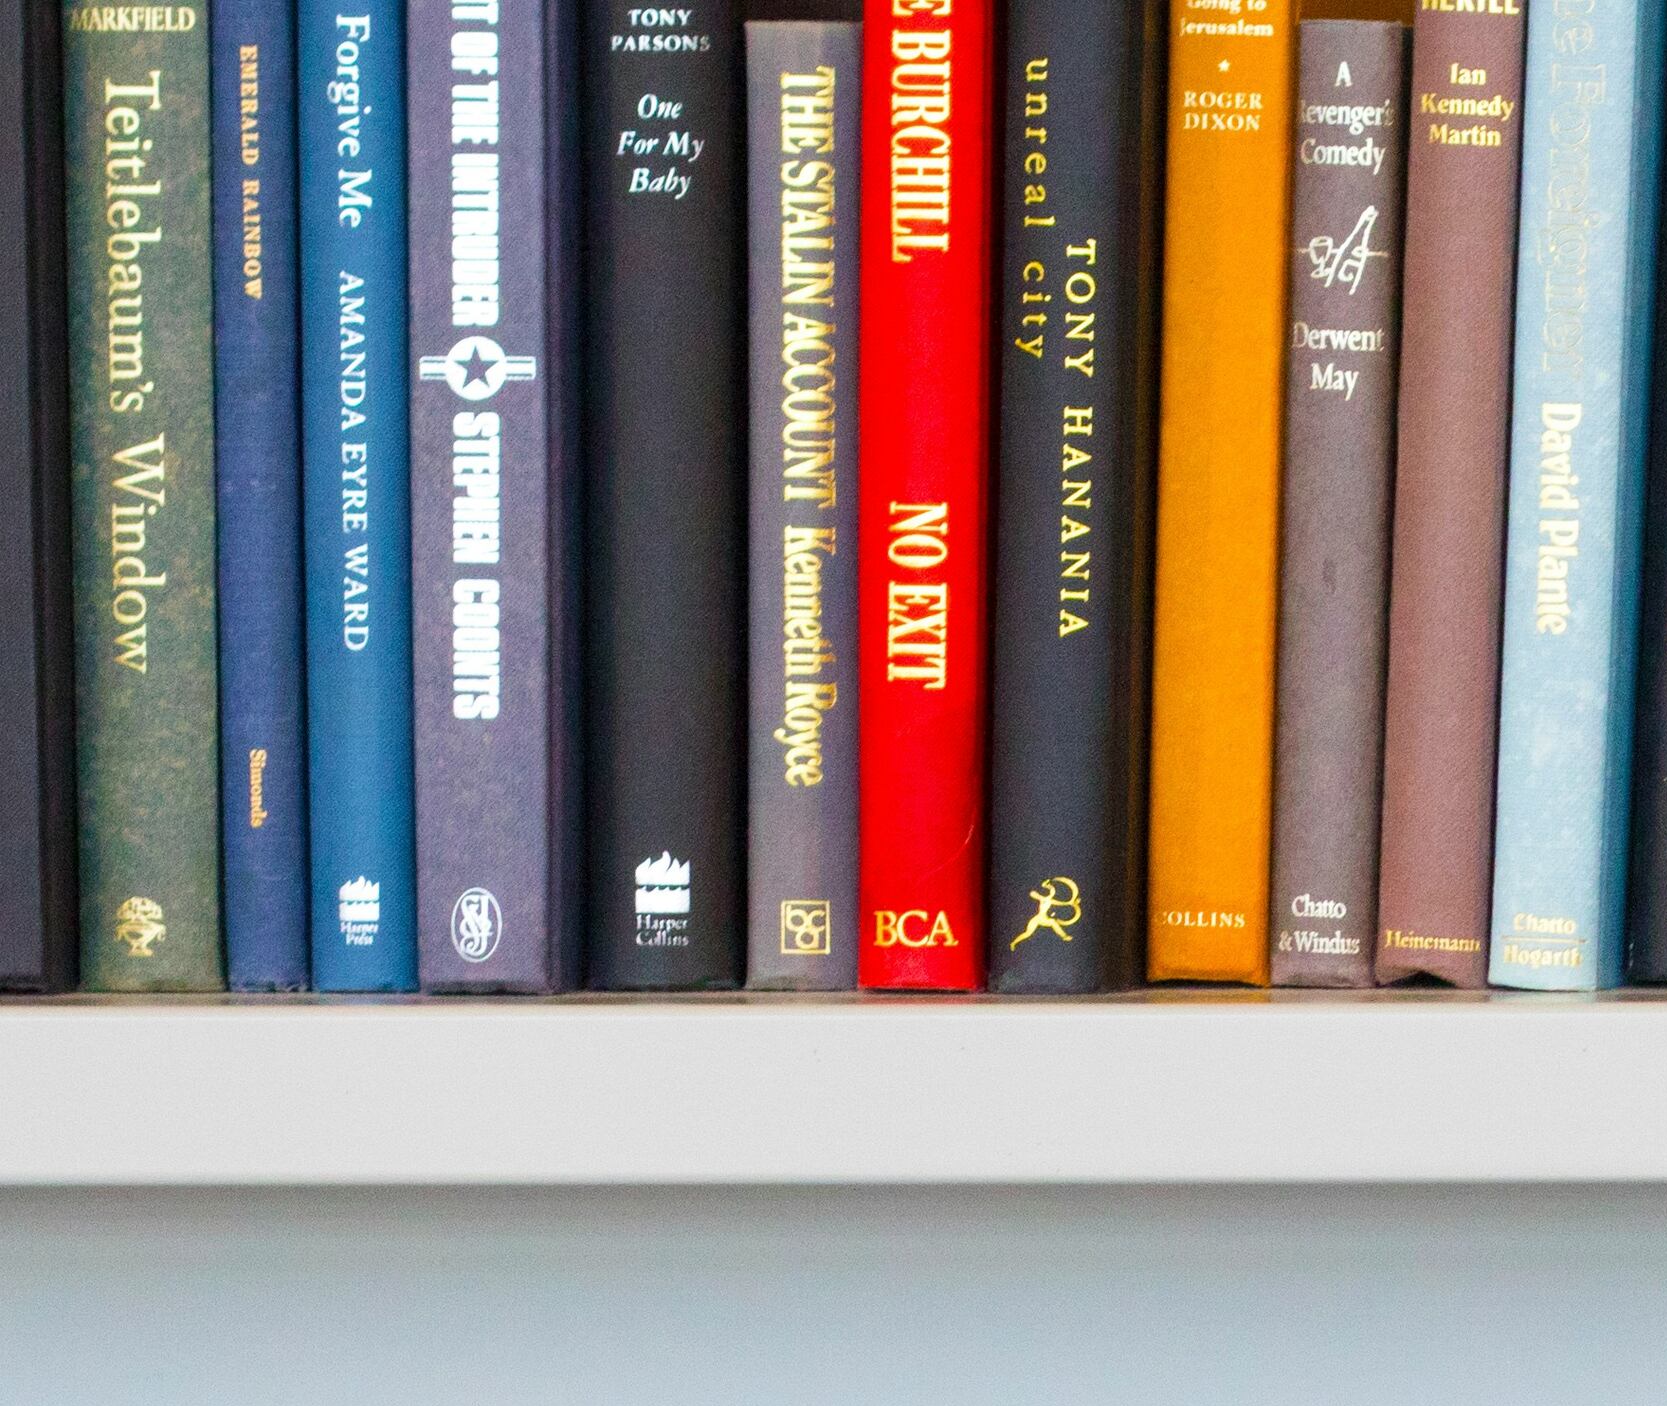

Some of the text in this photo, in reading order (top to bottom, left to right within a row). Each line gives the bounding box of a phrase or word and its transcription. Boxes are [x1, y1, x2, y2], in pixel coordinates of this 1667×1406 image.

[628, 8, 691, 27] TONY
[1450, 63, 1487, 86] Ian
[637, 94, 682, 119] One
[1185, 91, 1263, 109] ROGER
[1422, 94, 1514, 121] Kennedy
[1185, 113, 1260, 131] DIXON
[1430, 124, 1501, 147] Martin
[617, 131, 659, 155] For
[1303, 137, 1385, 175] Comedy
[240, 45, 262, 300] EMERALD RAINBOW
[629, 167, 690, 200] Baby
[1014, 58, 1056, 359] unreal city
[327, 14, 373, 651] Forgive Me AMANDA EYRE WARD
[105, 70, 167, 674] Teitlebaum's Window
[888, 29, 951, 688] BURCHILL NO EXIT
[452, 153, 500, 719] INTRUDER STEPHEN COONTS
[778, 66, 837, 788] THE STALIN ACCOUNT Kenneth Royce
[1059, 238, 1096, 637] TONY HANANIA
[1535, 403, 1583, 635] David Plante
[876, 910, 957, 947] BCA
